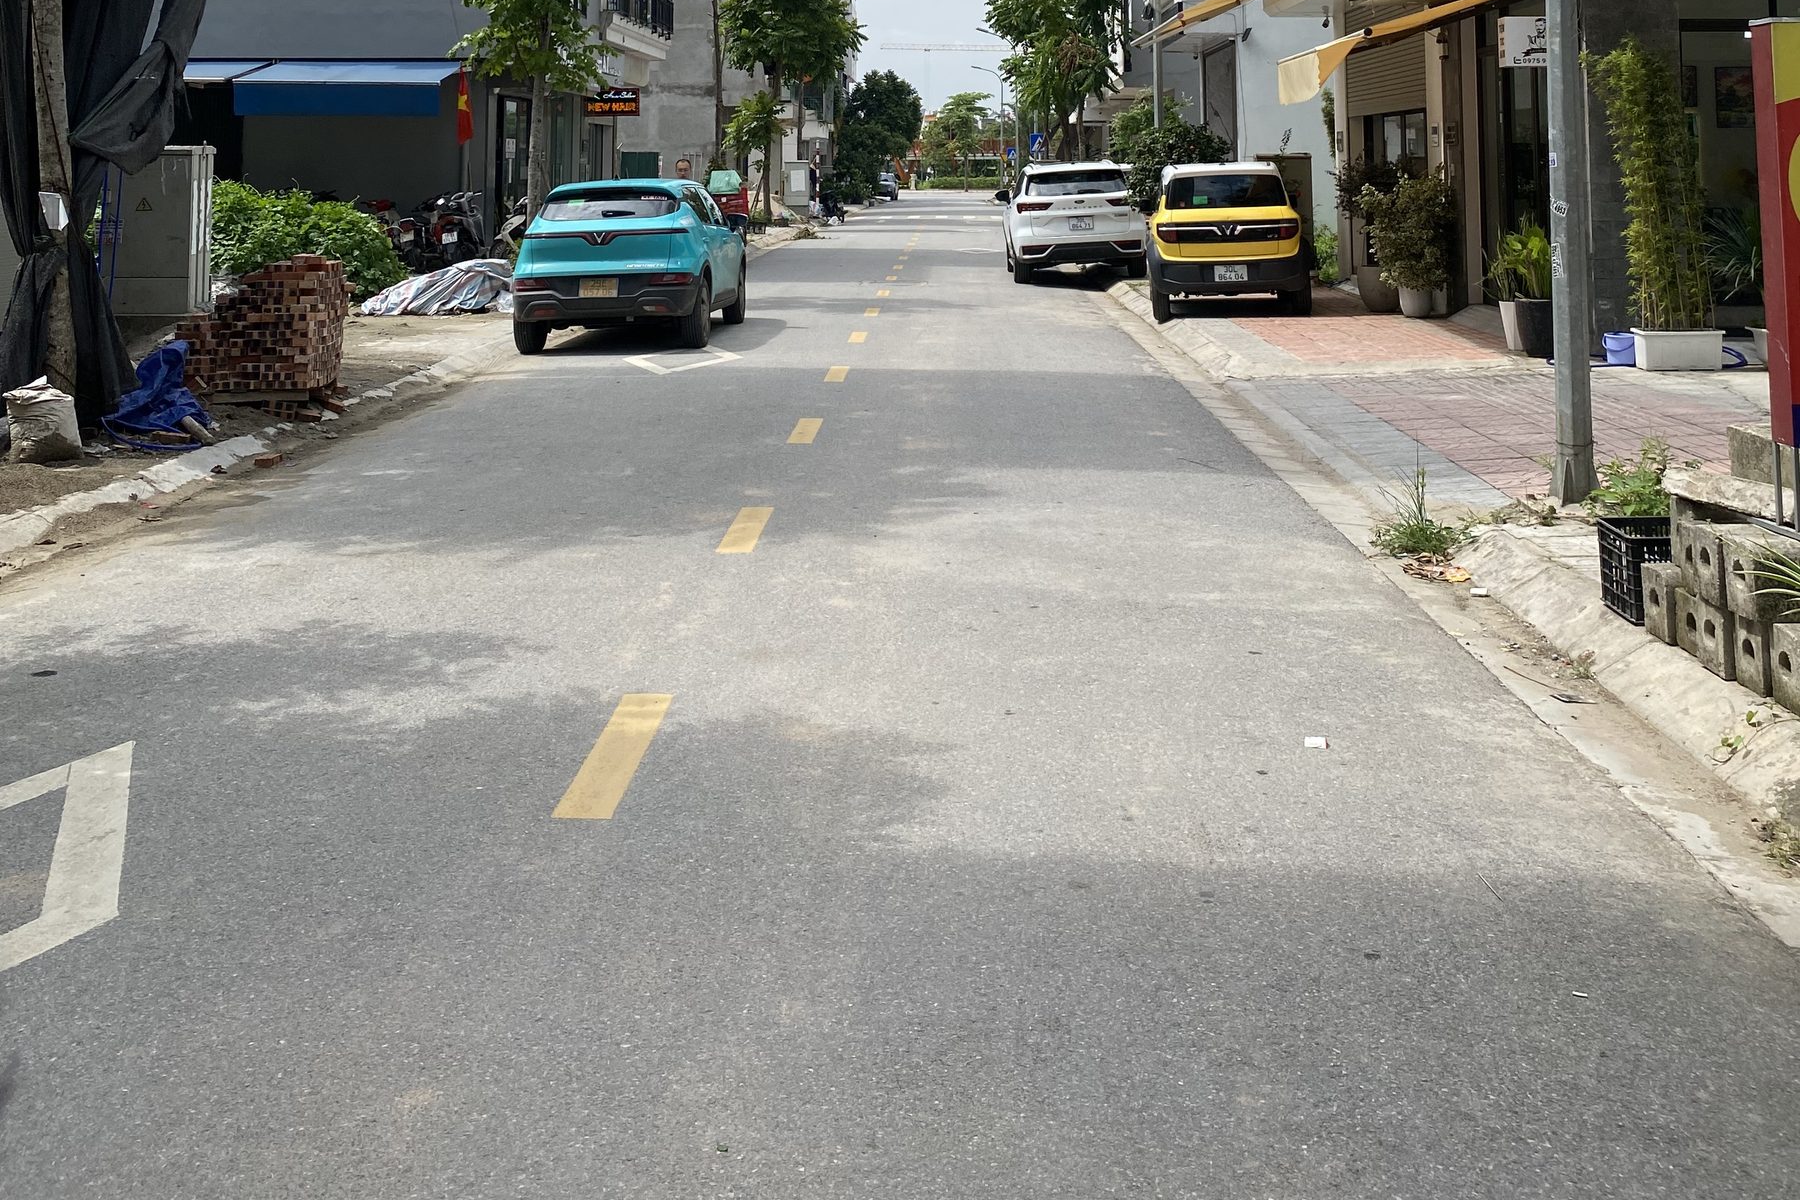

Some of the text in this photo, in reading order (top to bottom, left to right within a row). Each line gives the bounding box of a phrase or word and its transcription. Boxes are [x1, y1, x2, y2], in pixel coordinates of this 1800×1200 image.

[587, 102, 637, 112] NEW HAIR
[1223, 265, 1238, 273] 30L
